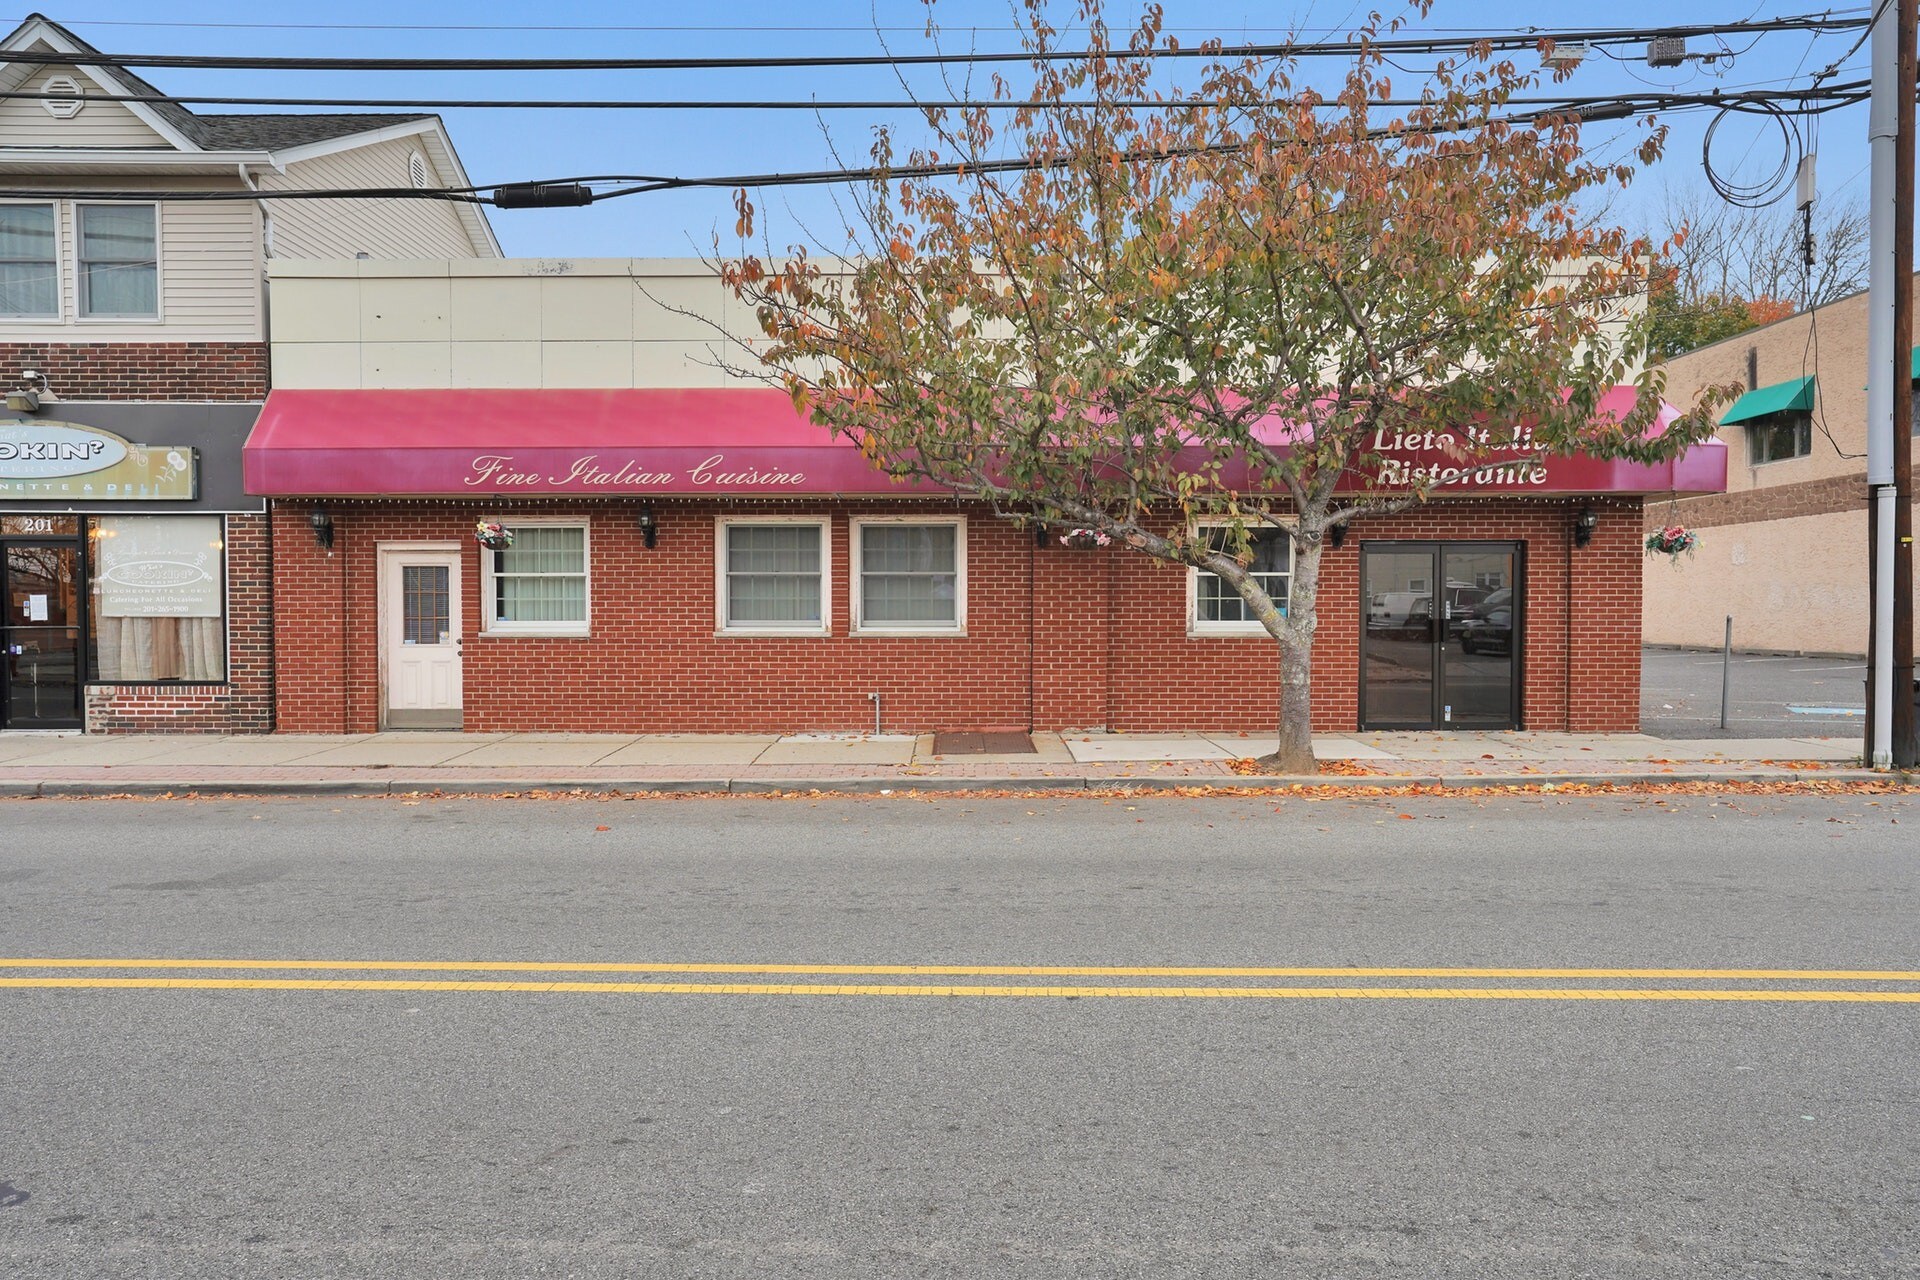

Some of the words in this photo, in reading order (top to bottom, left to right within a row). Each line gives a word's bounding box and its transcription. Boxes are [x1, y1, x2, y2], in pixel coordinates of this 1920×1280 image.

[464, 455, 541, 485] Fine
[548, 455, 675, 485] Italian
[686, 454, 806, 485] Cuisine
[83, 483, 93, 491] &
[107, 483, 159, 492] DELI
[25, 519, 53, 531] 201
